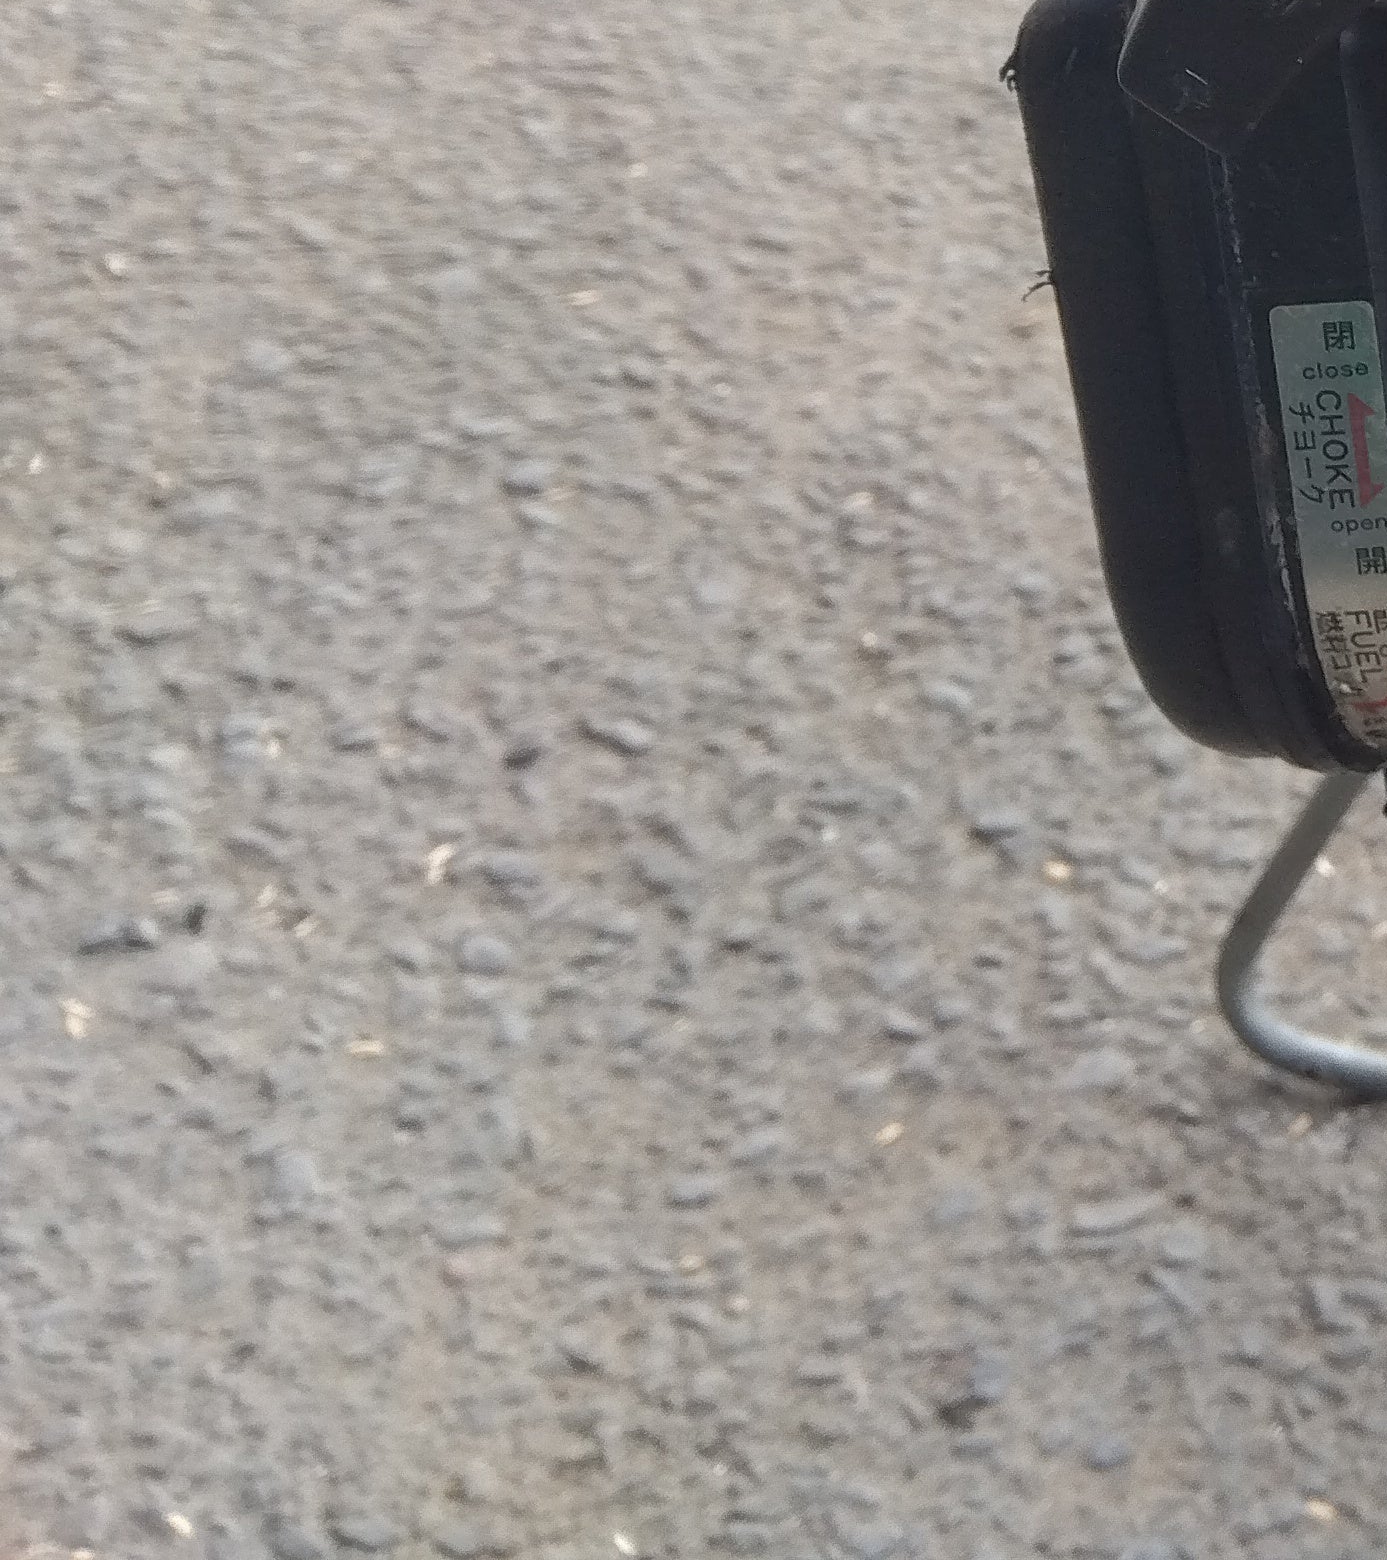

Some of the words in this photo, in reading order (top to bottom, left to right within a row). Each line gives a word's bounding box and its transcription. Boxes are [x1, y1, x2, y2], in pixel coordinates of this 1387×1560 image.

[1322, 320, 1356, 352] 閉
[1302, 361, 1369, 380] close
[1315, 389, 1357, 510] CHOKE
[1344, 609, 1383, 683] FUEL
